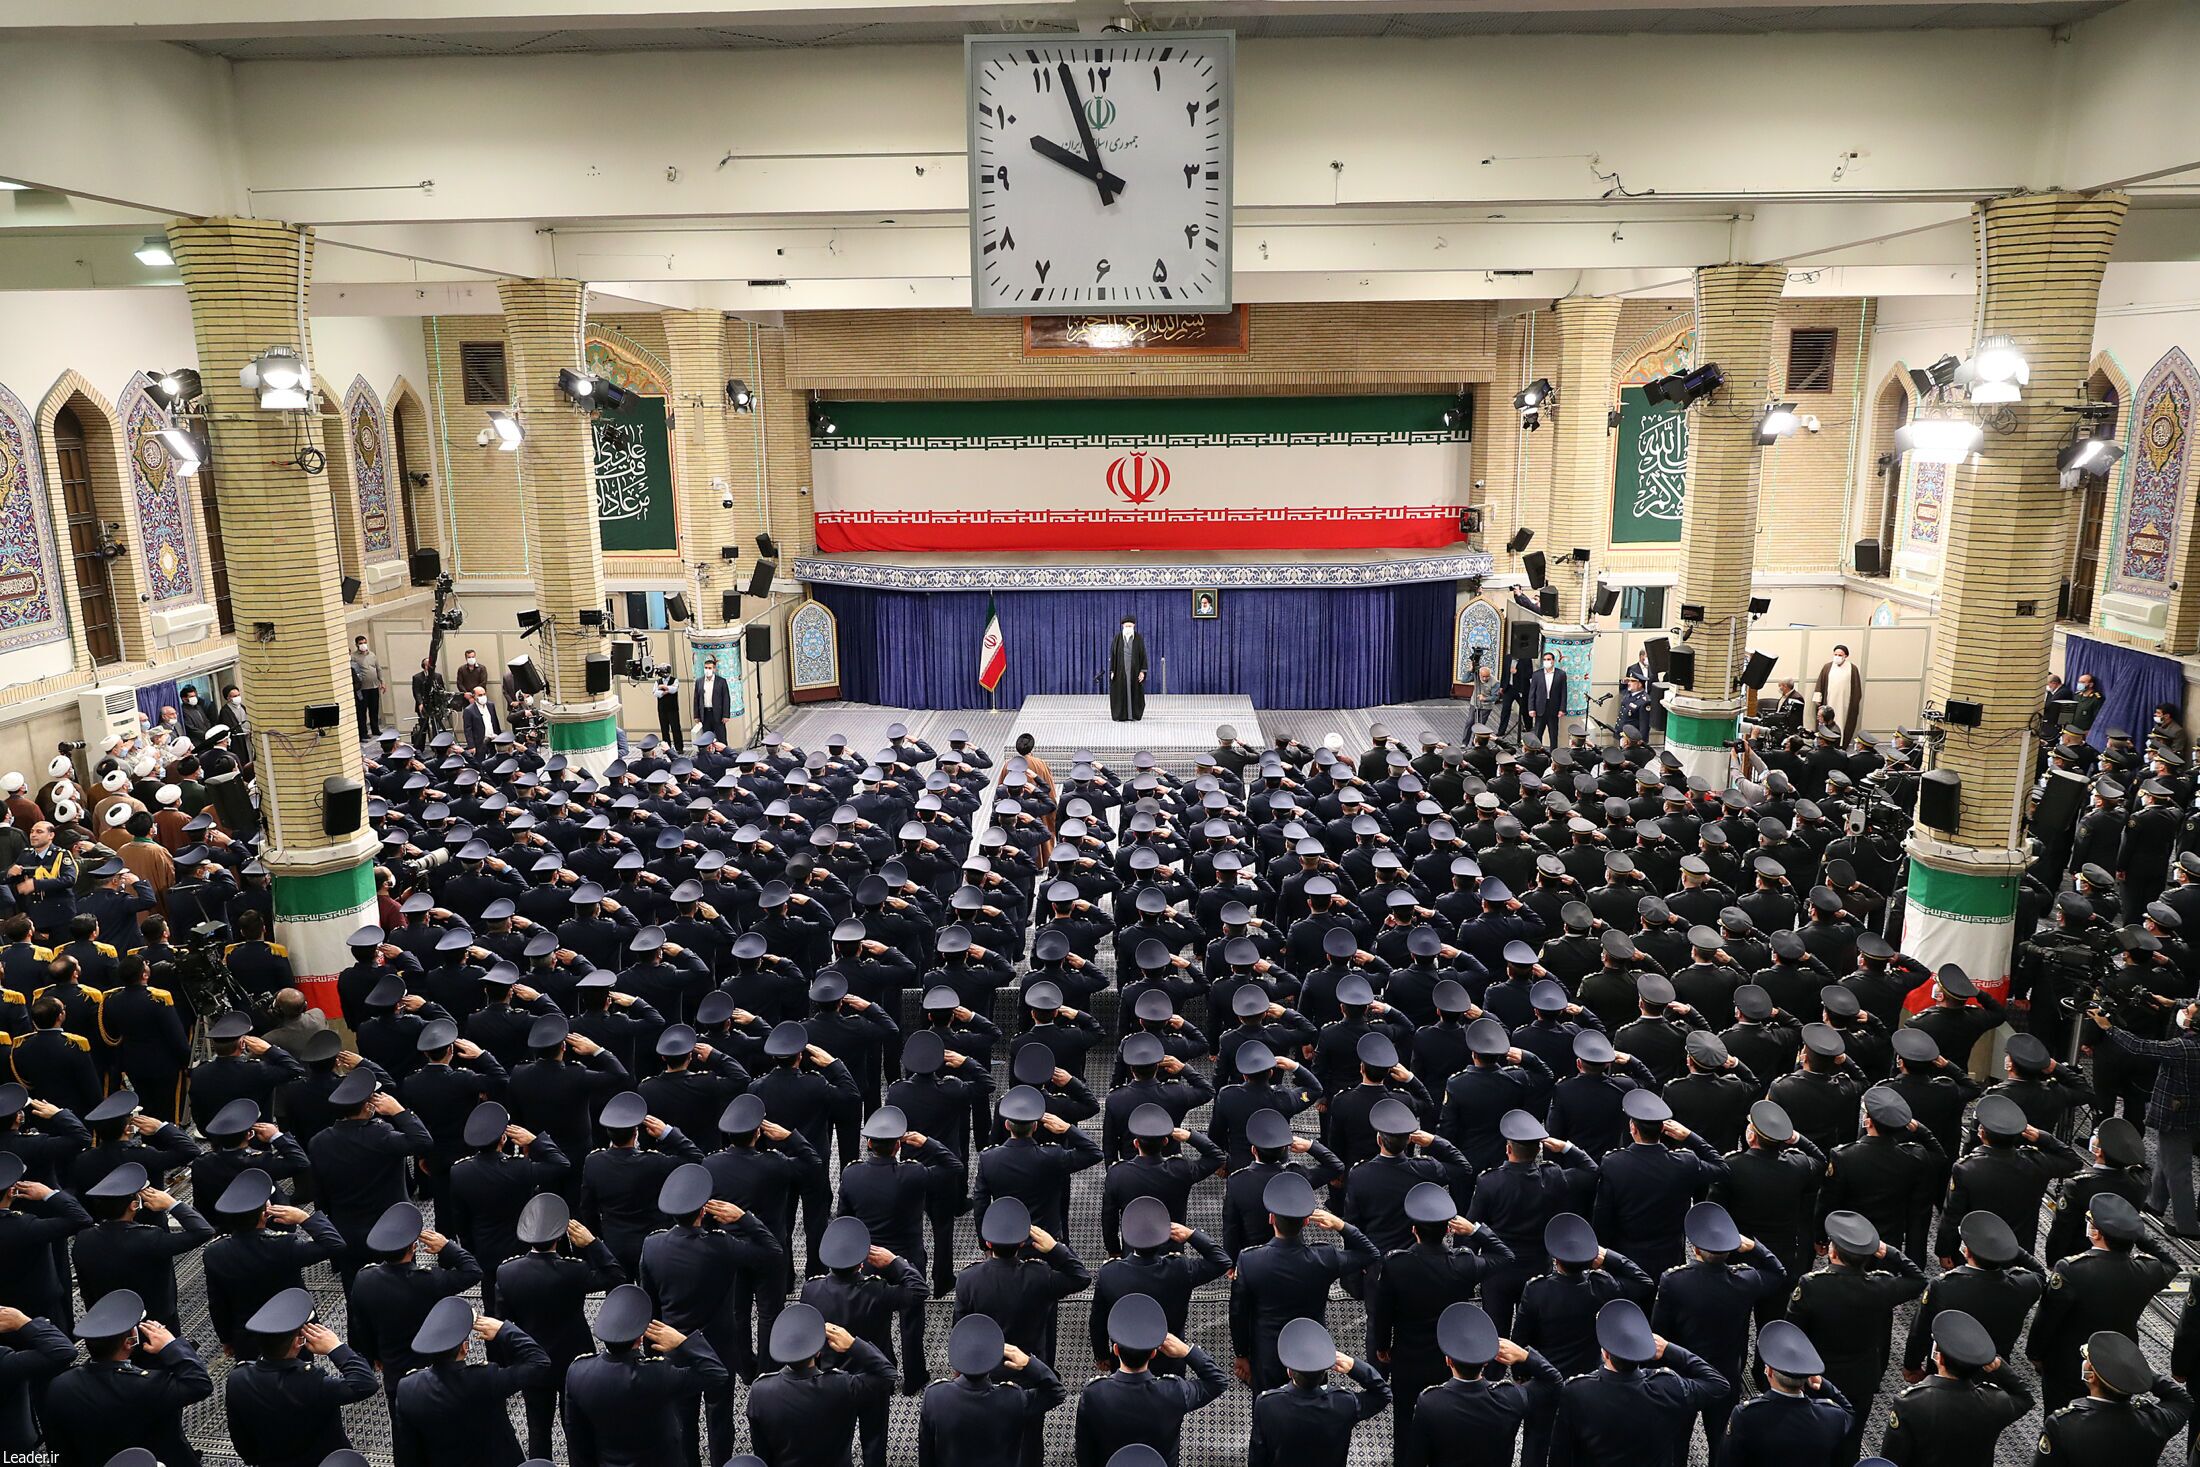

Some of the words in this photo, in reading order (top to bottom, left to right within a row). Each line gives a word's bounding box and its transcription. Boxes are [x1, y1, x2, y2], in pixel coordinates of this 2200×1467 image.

[1033, 67, 1050, 93] ۱۱
[1087, 66, 1111, 93] ۱۲
[1153, 66, 1161, 92] ۱
[996, 104, 1017, 130] ۱۰
[1186, 101, 1200, 127] ۲
[997, 165, 1010, 191] ۹
[1183, 163, 1200, 189] ۳
[999, 226, 1015, 251] ۸
[1184, 223, 1200, 249] ۴
[1035, 259, 1051, 284] ۷
[1095, 258, 1111, 284] ۶
[1152, 258, 1167, 283] ۵
